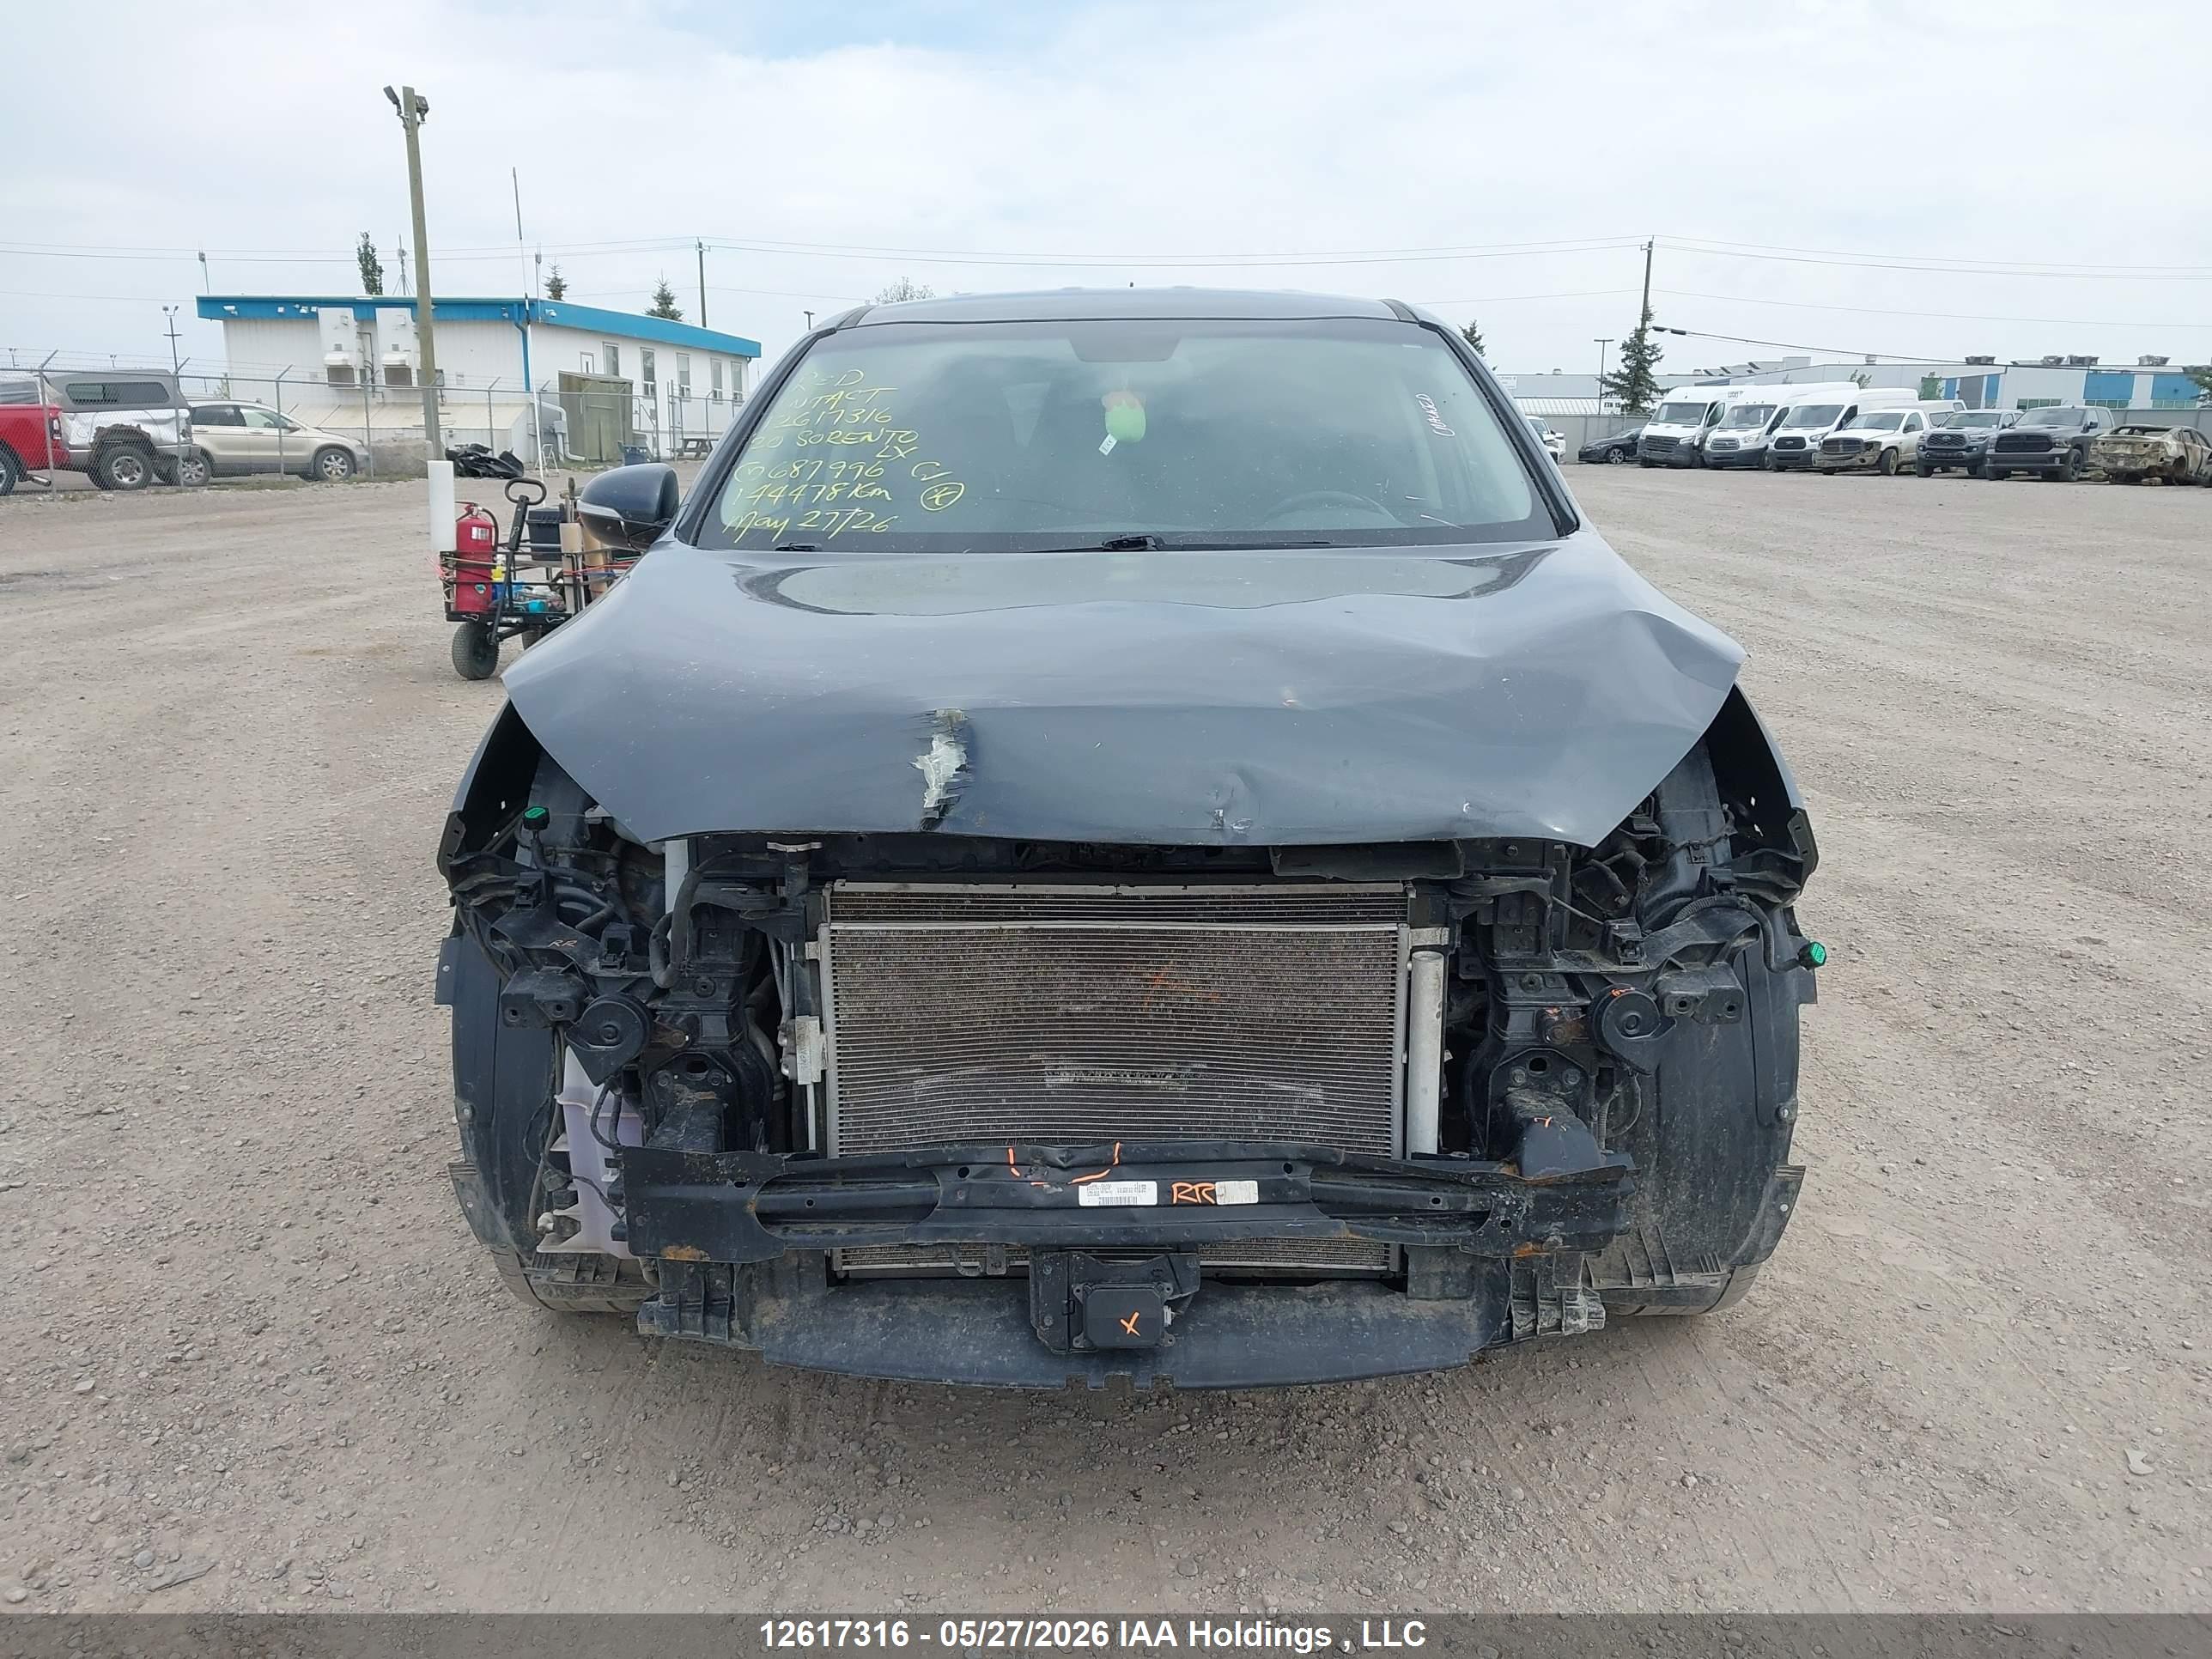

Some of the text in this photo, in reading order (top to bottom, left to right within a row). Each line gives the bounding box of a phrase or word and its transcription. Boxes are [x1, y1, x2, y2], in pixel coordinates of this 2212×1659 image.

[796, 428, 919, 447] SORENTO
[722, 507, 900, 543] May 27/26
